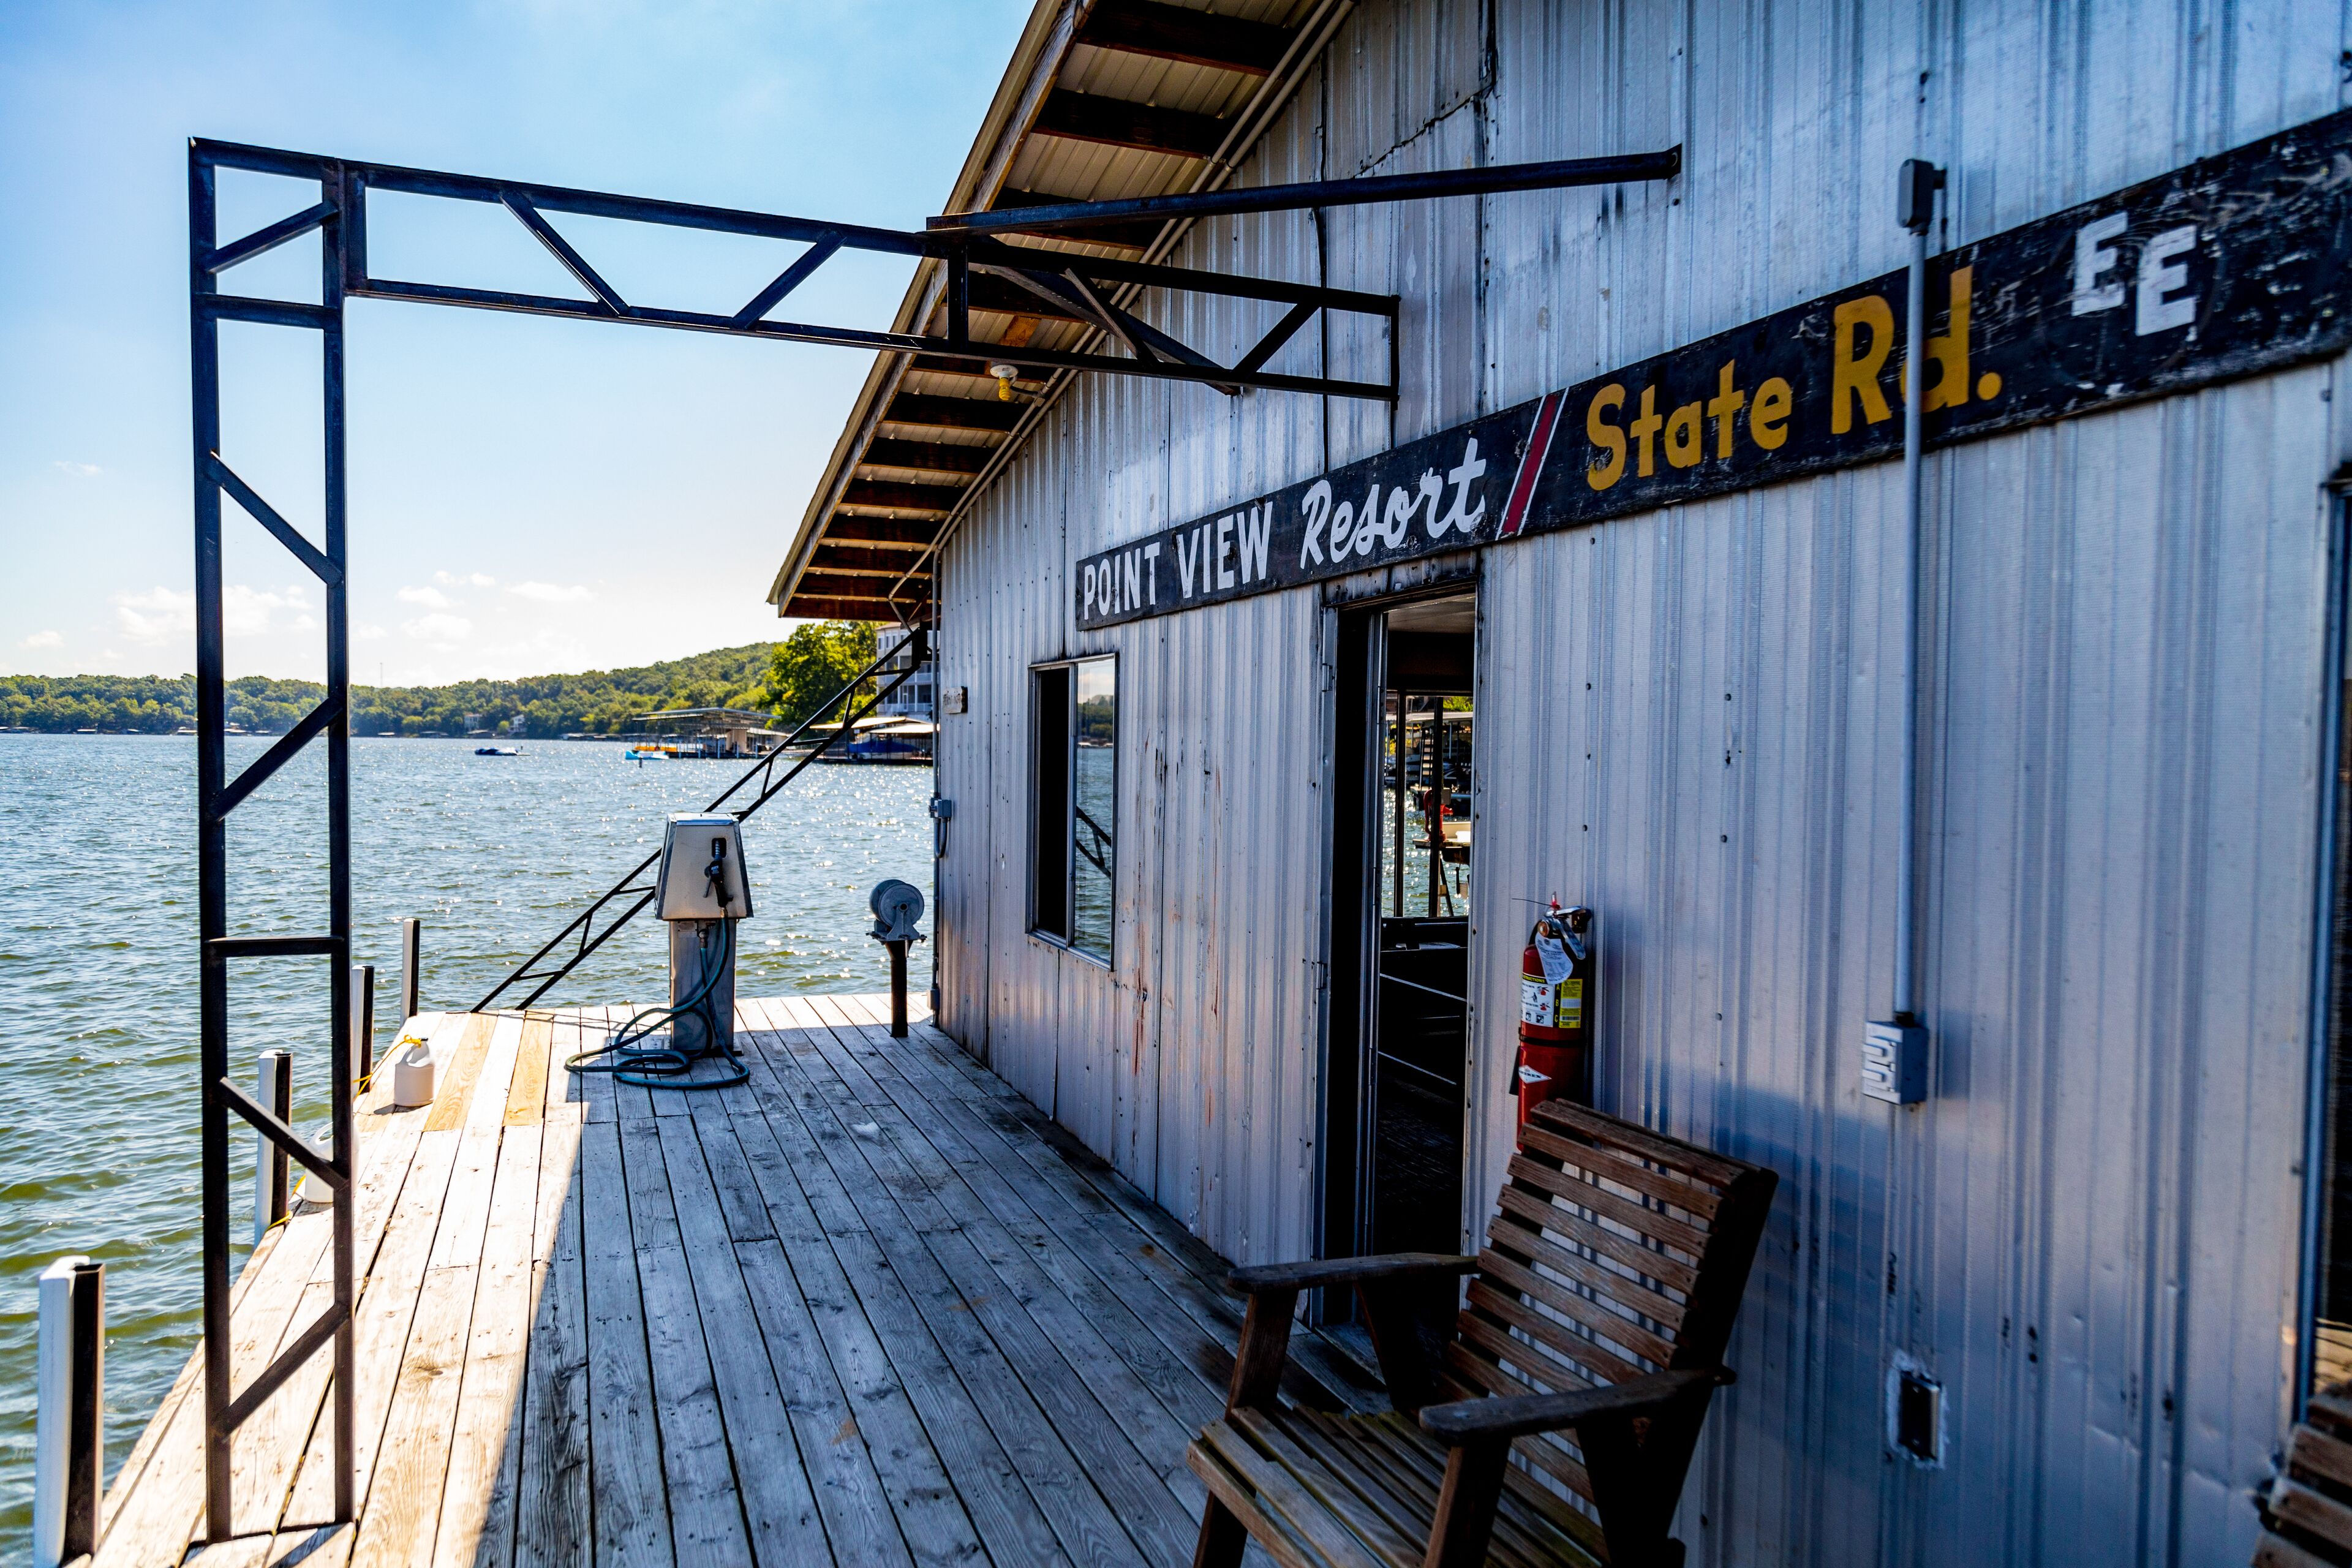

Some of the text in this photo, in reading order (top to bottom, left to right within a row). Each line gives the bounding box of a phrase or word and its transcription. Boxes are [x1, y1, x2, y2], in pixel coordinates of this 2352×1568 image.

[1084, 209, 2198, 620] POINT VIEW Resort State Rd. EE
[1554, 1014, 1559, 1023] C
